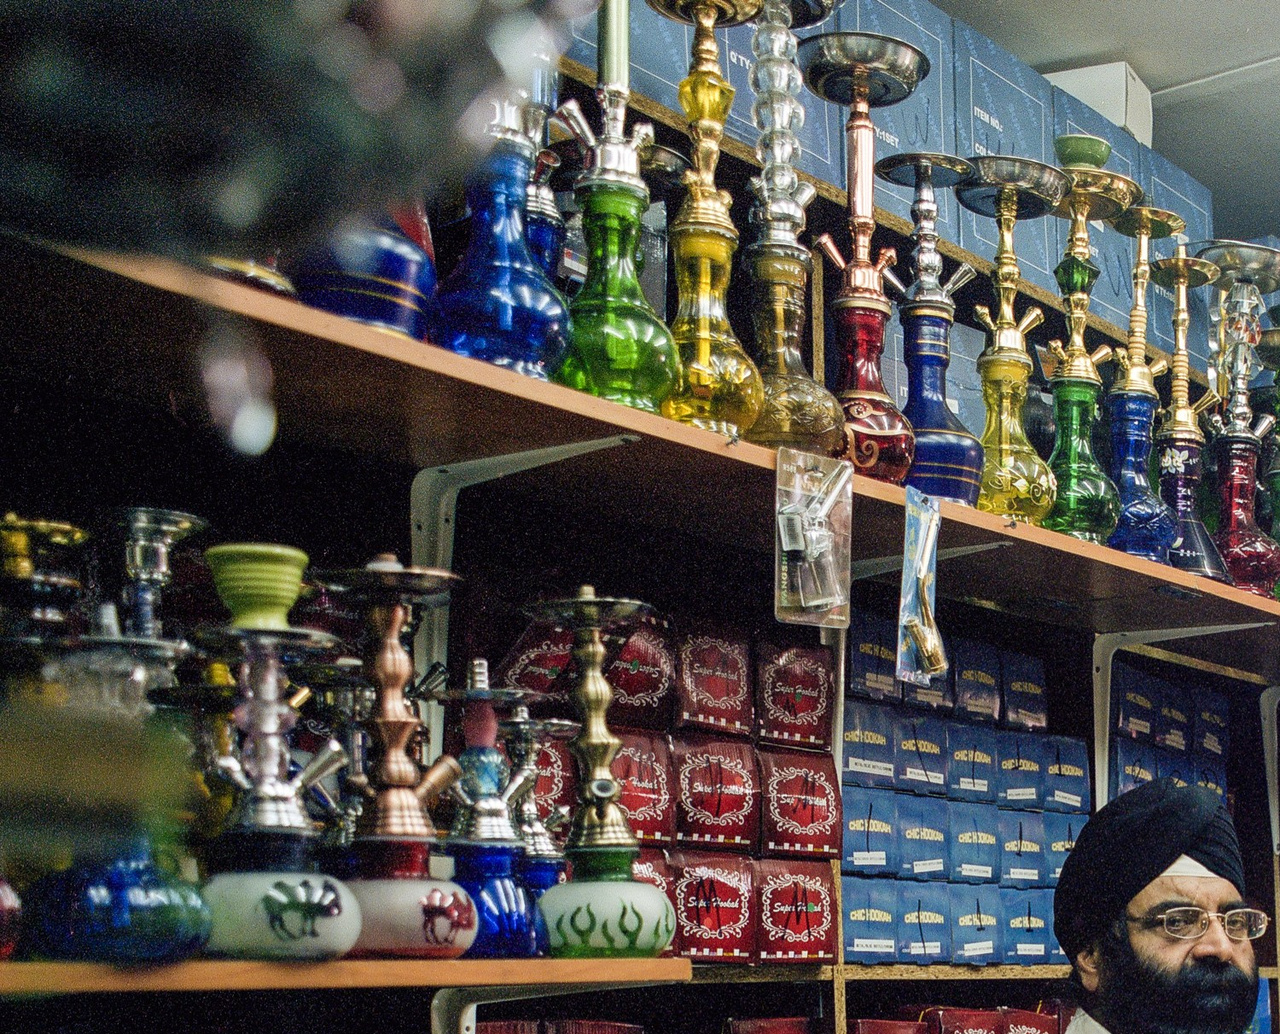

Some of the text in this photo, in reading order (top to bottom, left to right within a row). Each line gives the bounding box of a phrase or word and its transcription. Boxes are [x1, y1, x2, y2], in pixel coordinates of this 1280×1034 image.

[974, 106, 989, 123] ITEM
[694, 664, 739, 681] Super Hookah
[775, 682, 819, 697] Super Hookah
[844, 730, 887, 746] CHIC HOOKAH
[901, 739, 941, 754] CHIC HOOKAH
[954, 750, 992, 764] CHIC HOOKAH
[1002, 758, 1039, 772] CHIC HOOKAH
[1048, 764, 1084, 776] CHIC HOOKAH
[849, 819, 891, 833] CHIC HOOKAH
[905, 827, 944, 841] CHIC HOOKAH
[958, 831, 996, 844] CHIC HOOKAH
[1004, 841, 1018, 852] CHIC
[1052, 841, 1065, 851] CHIC
[688, 896, 740, 909] Super Hookah
[773, 902, 796, 914] Super
[850, 908, 892, 923] CHIC HOOKAH
[904, 911, 944, 924] CHIC HOOKAH
[959, 915, 973, 927] CHIC
[1010, 917, 1023, 928] CHIC
